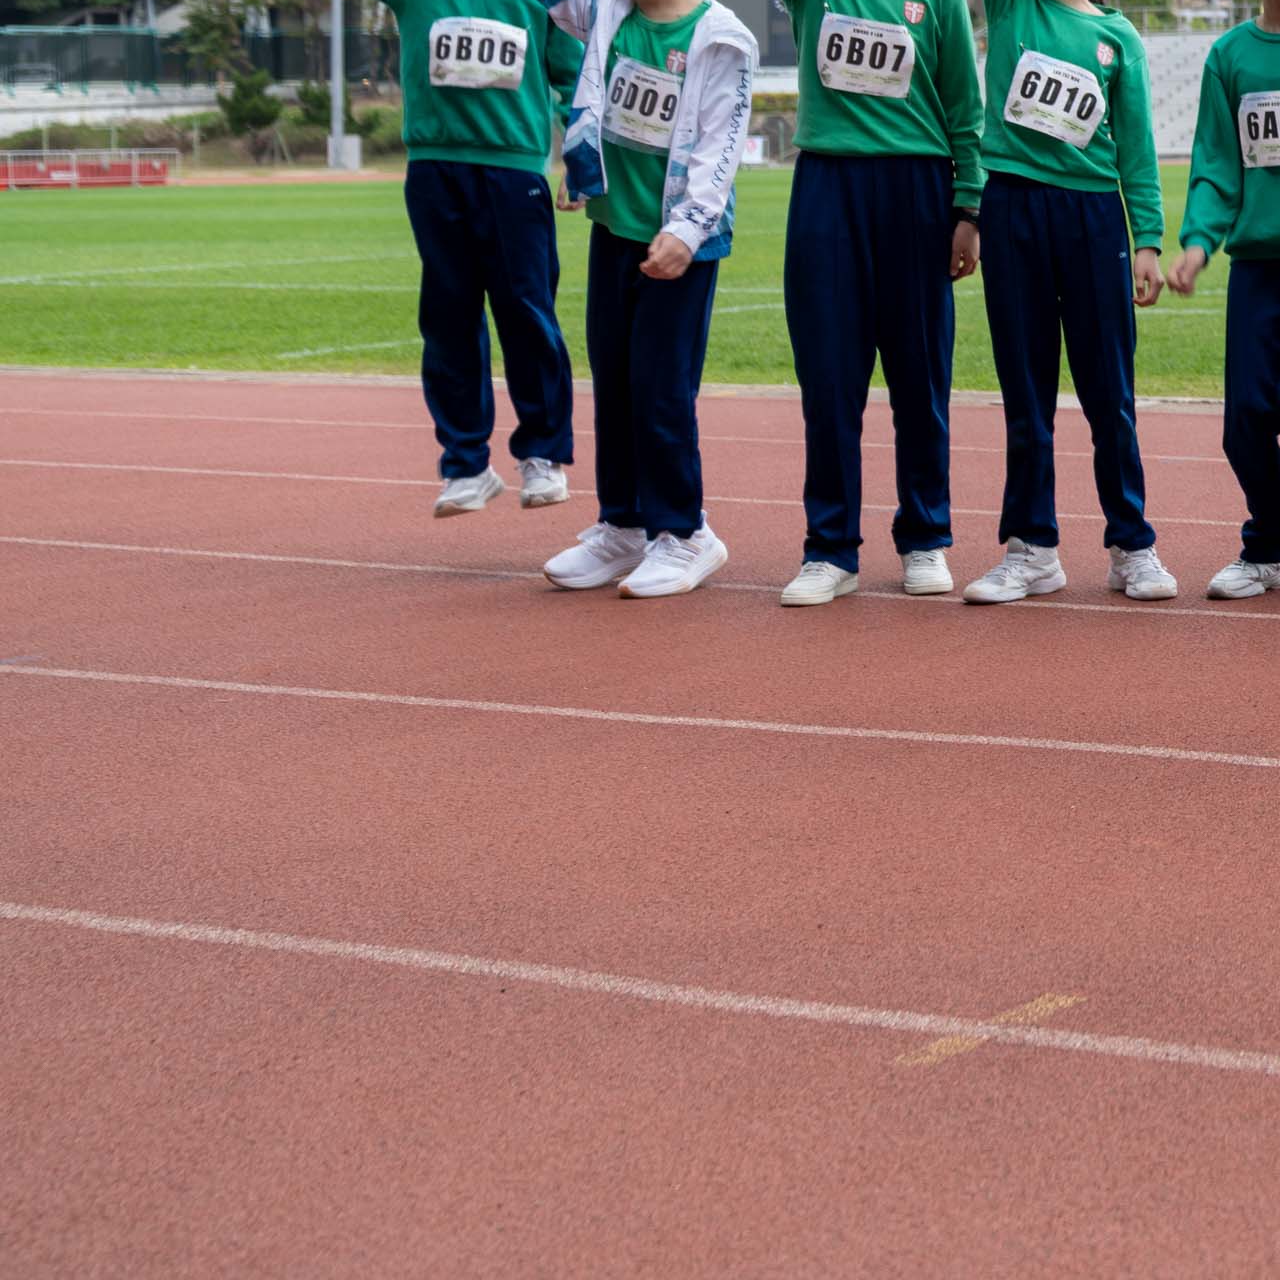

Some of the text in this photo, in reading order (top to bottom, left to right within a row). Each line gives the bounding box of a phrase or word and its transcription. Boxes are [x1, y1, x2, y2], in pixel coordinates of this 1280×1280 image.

[435, 34, 517, 66] 6B06
[826, 33, 906, 72] 6B07
[610, 77, 677, 121] 6D09
[1020, 71, 1097, 120] 6D10
